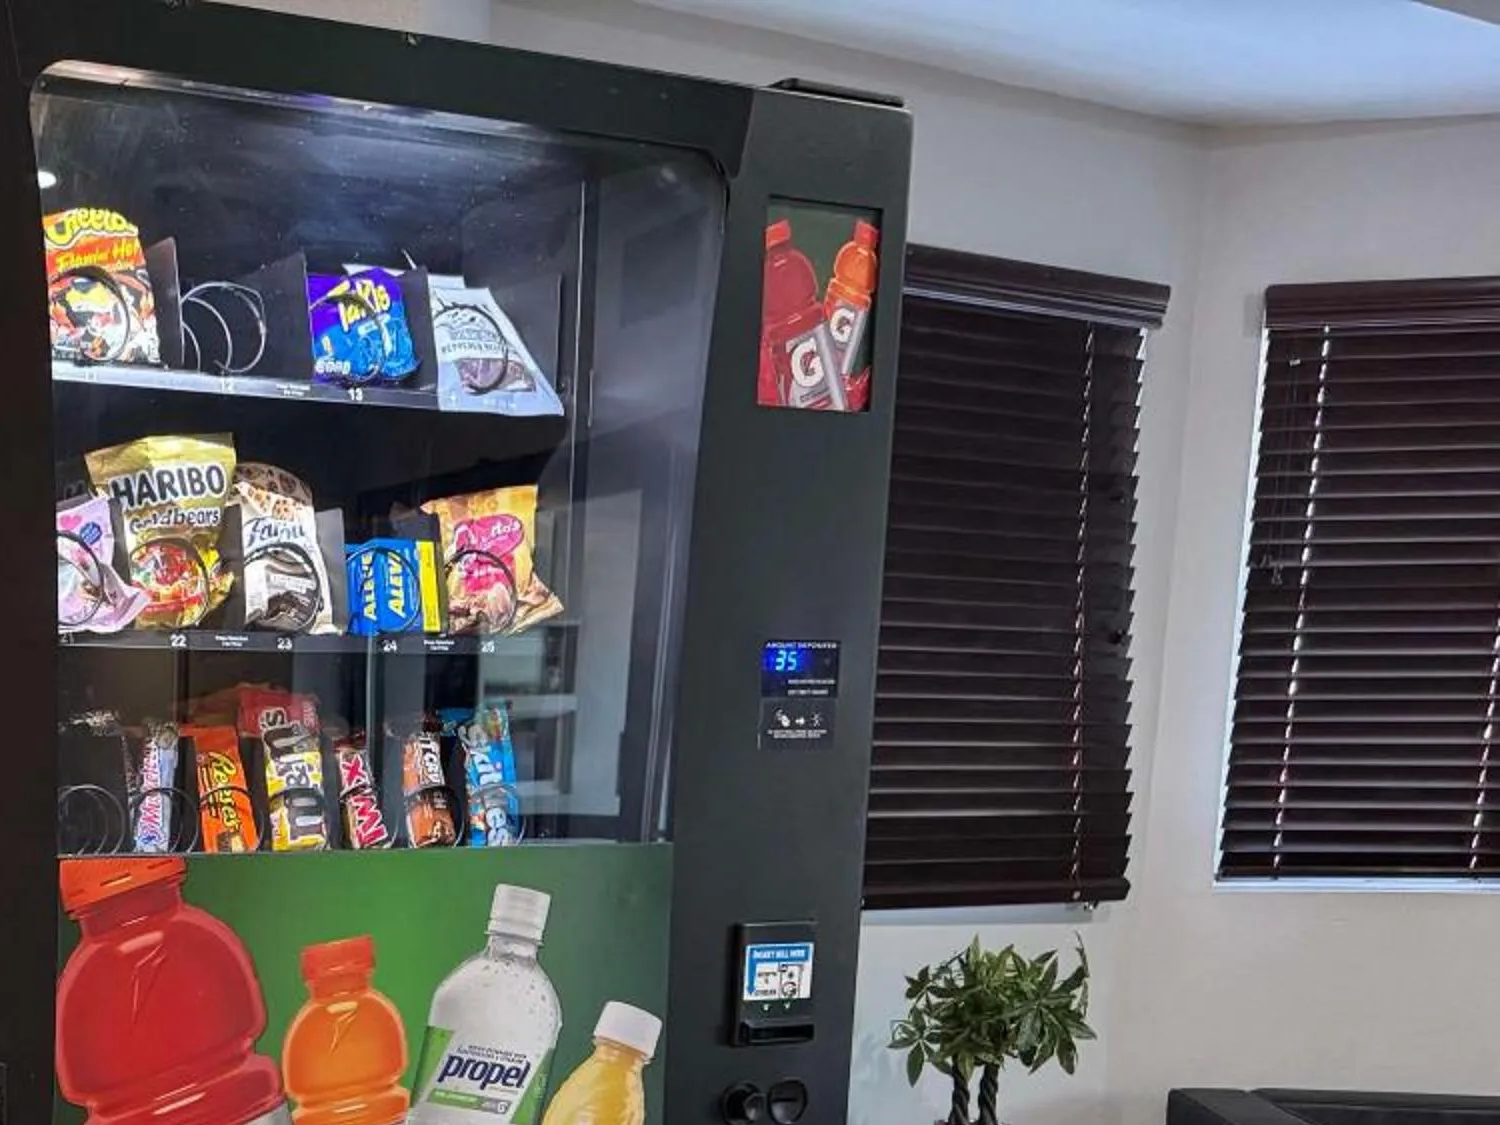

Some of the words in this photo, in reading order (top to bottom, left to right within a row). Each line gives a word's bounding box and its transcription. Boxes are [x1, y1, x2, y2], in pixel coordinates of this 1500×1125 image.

[830, 308, 855, 343] G
[791, 337, 824, 387] G
[348, 387, 363, 400] 13
[111, 464, 225, 507] HARIBO
[171, 634, 187, 647] 22
[277, 638, 292, 649] 23
[382, 640, 397, 652] 24
[775, 650, 797, 671] 35
[437, 1054, 531, 1090] propel
